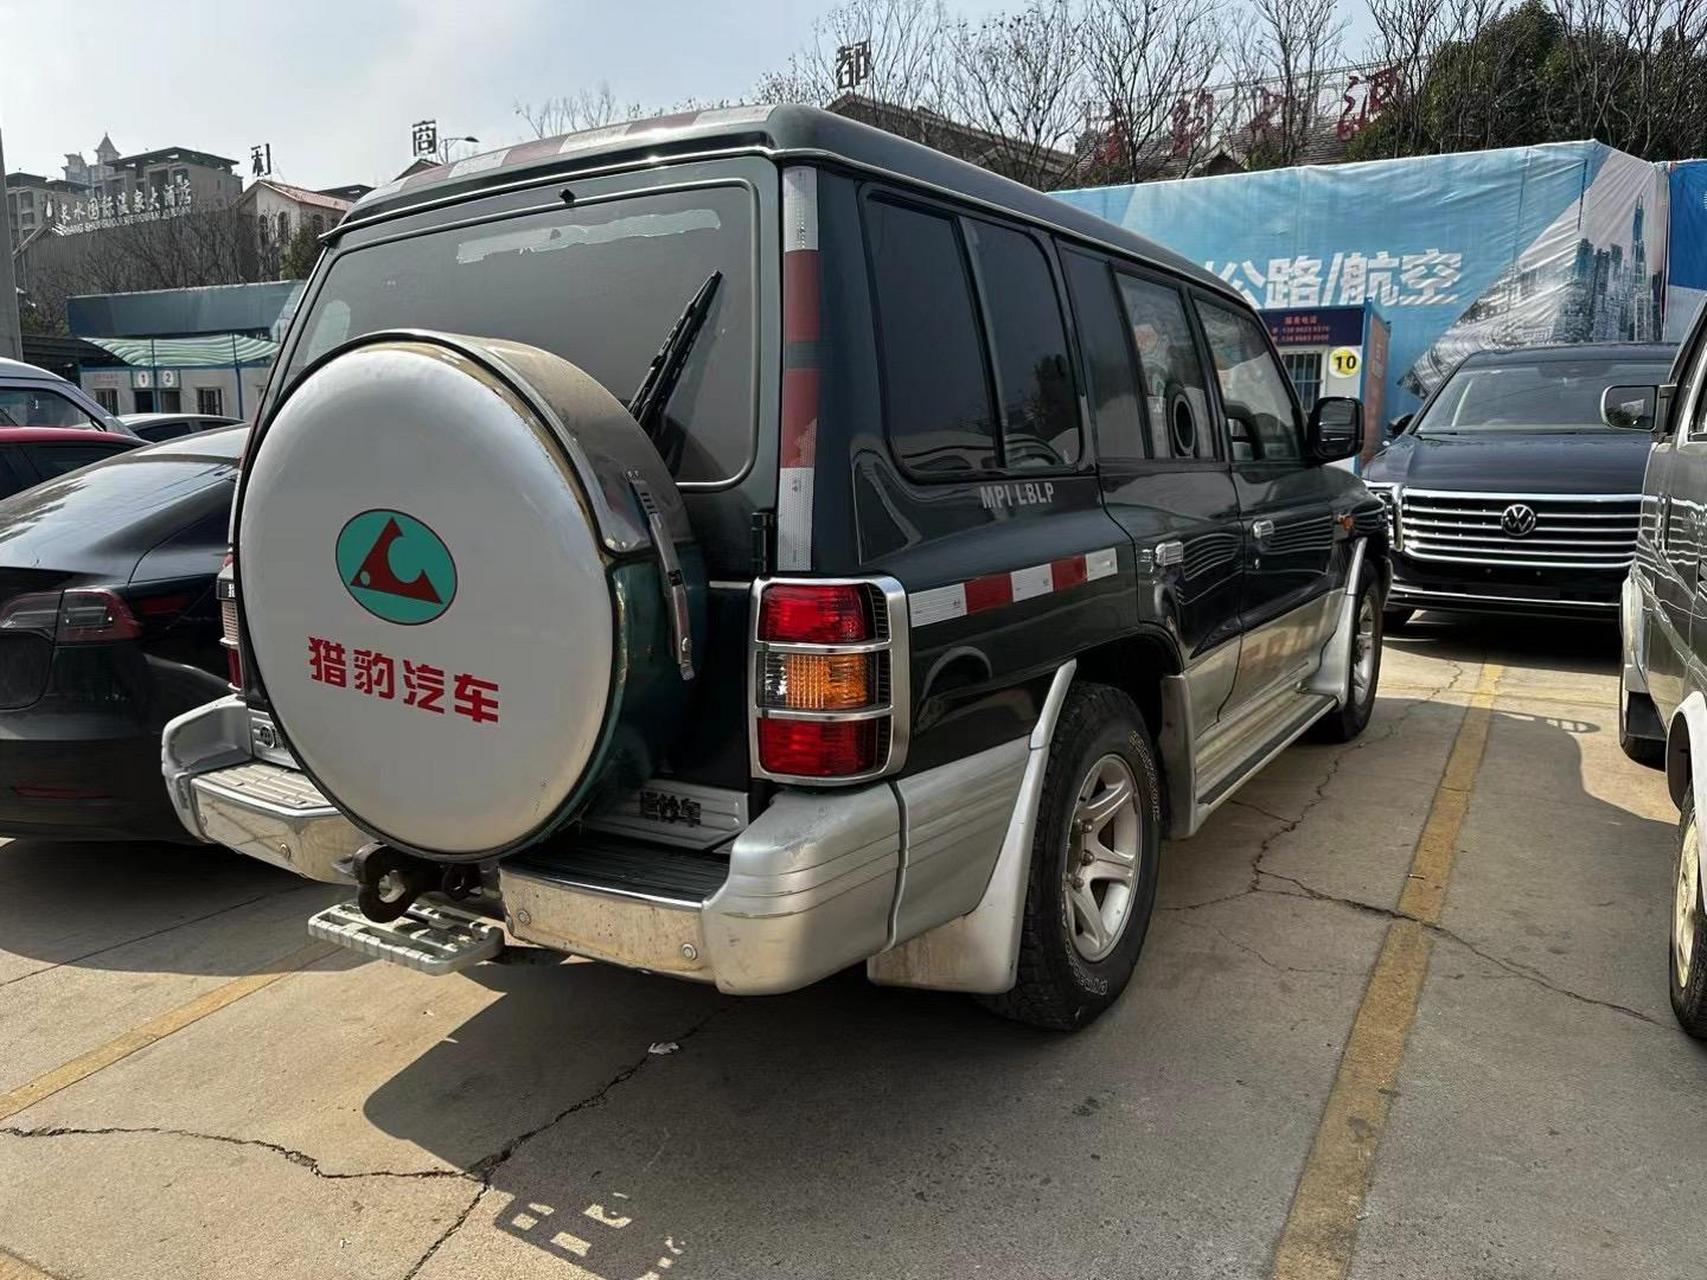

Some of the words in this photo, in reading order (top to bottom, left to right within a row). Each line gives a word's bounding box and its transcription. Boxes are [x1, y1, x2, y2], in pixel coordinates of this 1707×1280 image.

[251, 143, 271, 176] 利
[412, 120, 437, 156] 商
[836, 41, 871, 89] 都
[1335, 354, 1357, 371] 10
[980, 484, 1012, 508] MPI
[308, 636, 499, 723] 猎豹汽车
